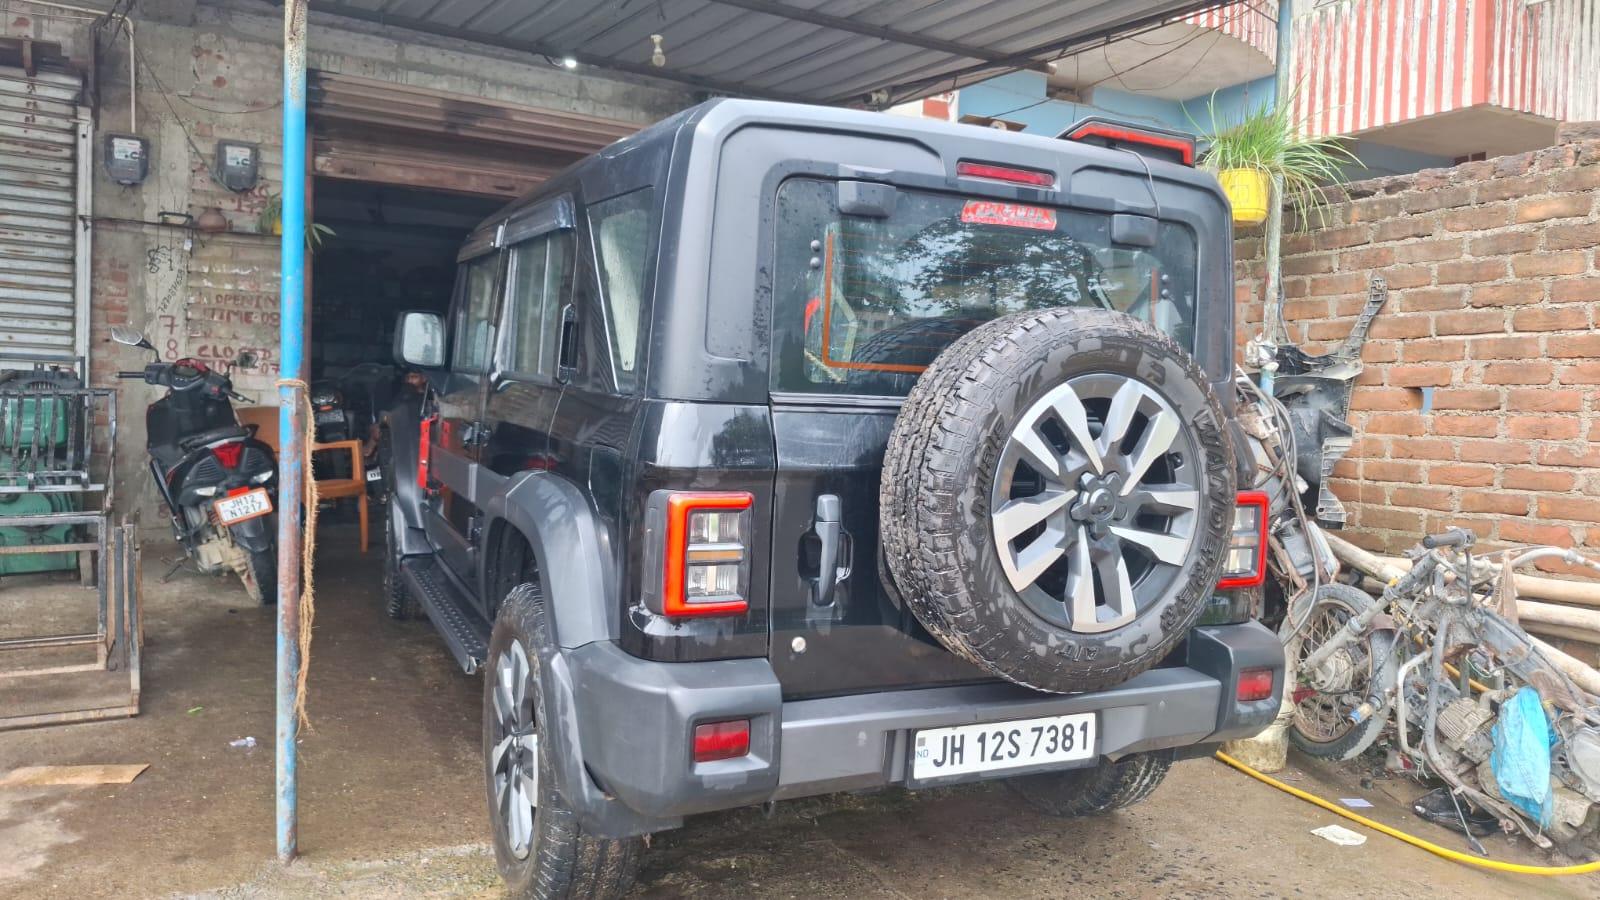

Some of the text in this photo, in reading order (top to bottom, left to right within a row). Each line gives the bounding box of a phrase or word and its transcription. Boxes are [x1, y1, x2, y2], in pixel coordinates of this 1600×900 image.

[932, 720, 1089, 768] JH 12S 7381
